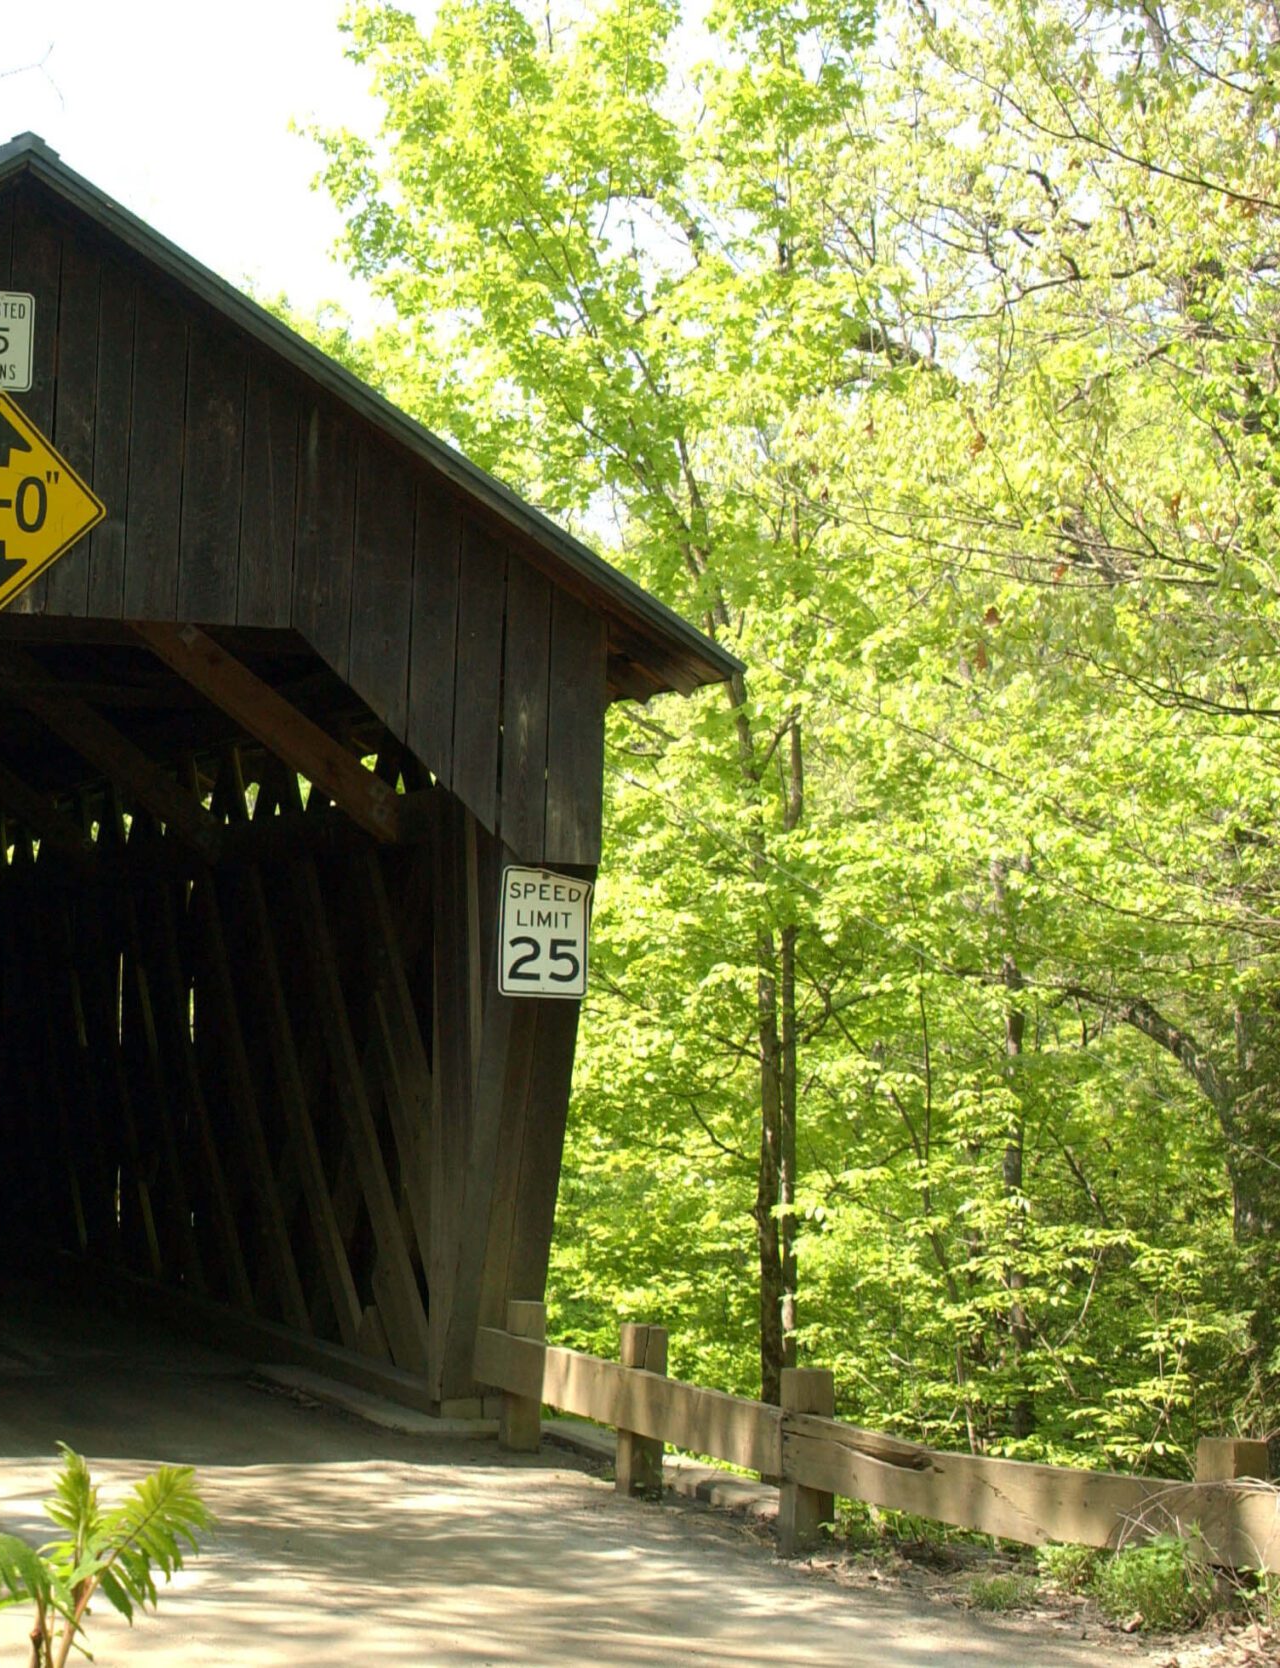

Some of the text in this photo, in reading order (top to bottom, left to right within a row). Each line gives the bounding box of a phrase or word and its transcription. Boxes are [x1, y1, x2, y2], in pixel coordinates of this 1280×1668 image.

[510, 882, 581, 902] SPEED
[517, 909, 572, 929] LIMIT
[508, 936, 580, 982] 25
